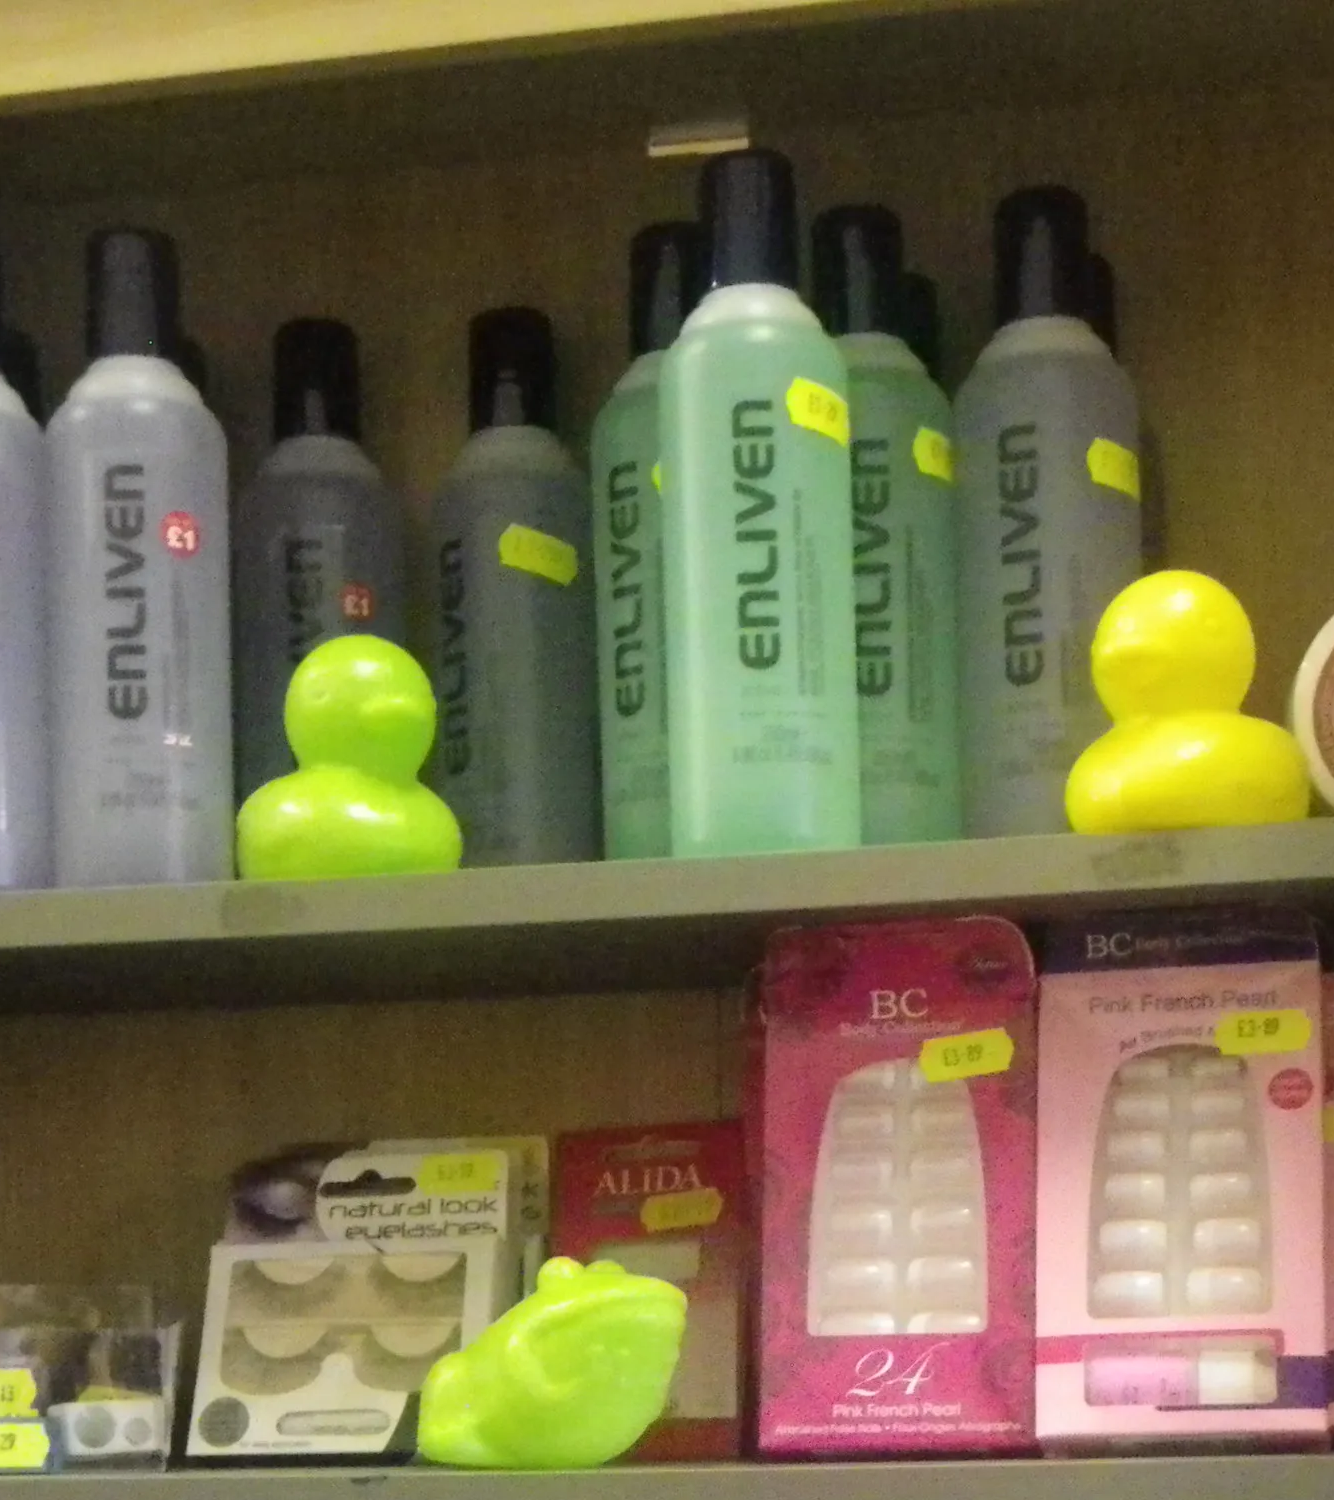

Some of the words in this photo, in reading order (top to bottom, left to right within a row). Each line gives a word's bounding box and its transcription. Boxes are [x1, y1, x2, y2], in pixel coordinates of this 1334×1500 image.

[869, 987, 930, 1020] BC
[593, 1162, 703, 1199] ALIDA
[328, 1197, 432, 1219] natural
[439, 1197, 498, 1215] look
[344, 1219, 499, 1241] eyelashes
[845, 1342, 951, 1398] 24
[867, 1403, 919, 1418] French
